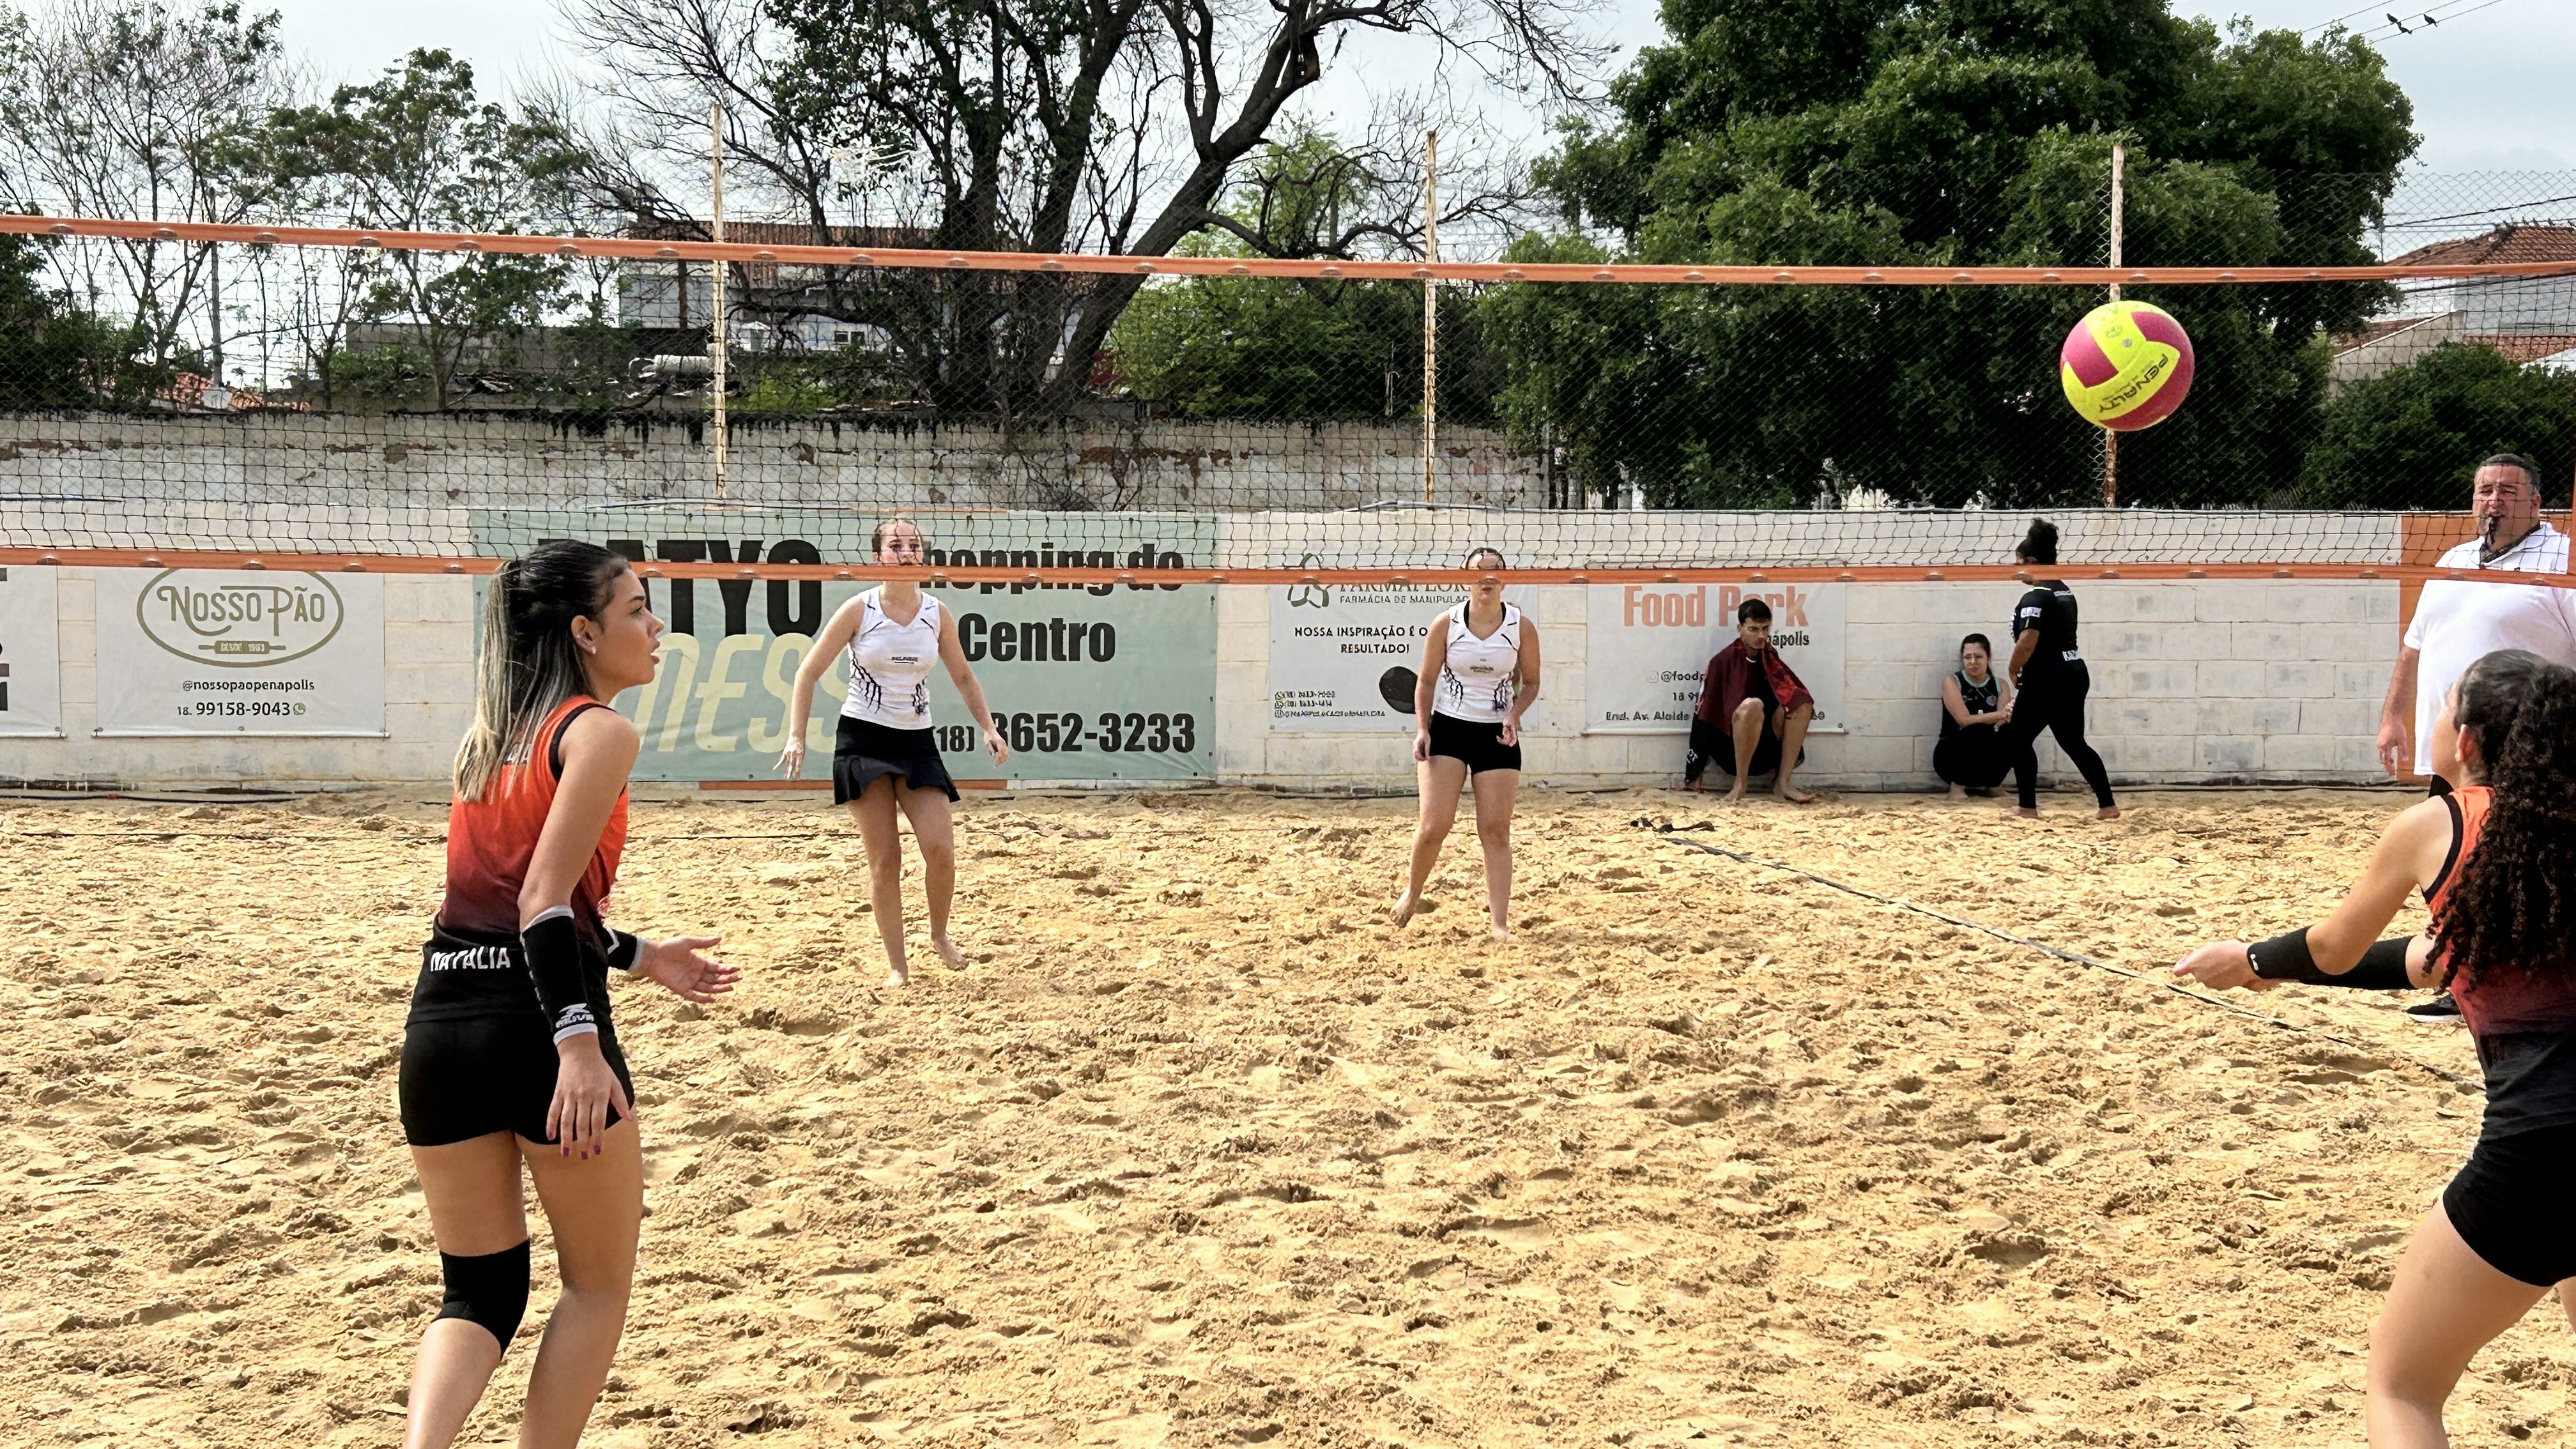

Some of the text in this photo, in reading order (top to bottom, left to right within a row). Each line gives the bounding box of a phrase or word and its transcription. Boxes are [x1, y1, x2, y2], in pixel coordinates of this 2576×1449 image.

[2099, 353, 2168, 413] PENALTY
[220, 585, 325, 636] PÃO
[1624, 585, 1809, 627] Food Prk
[958, 613, 1116, 662] Centro
[1294, 626, 1333, 637] NOSSA
[1337, 625, 1406, 640] INSPIRAÇÃO
[1418, 627, 1428, 637] O
[1341, 643, 1409, 654] RESULTADO!
[182, 679, 314, 693] @nossopaopenapolis
[195, 702, 291, 716] 99158-9043
[430, 946, 510, 972] NATALIA
